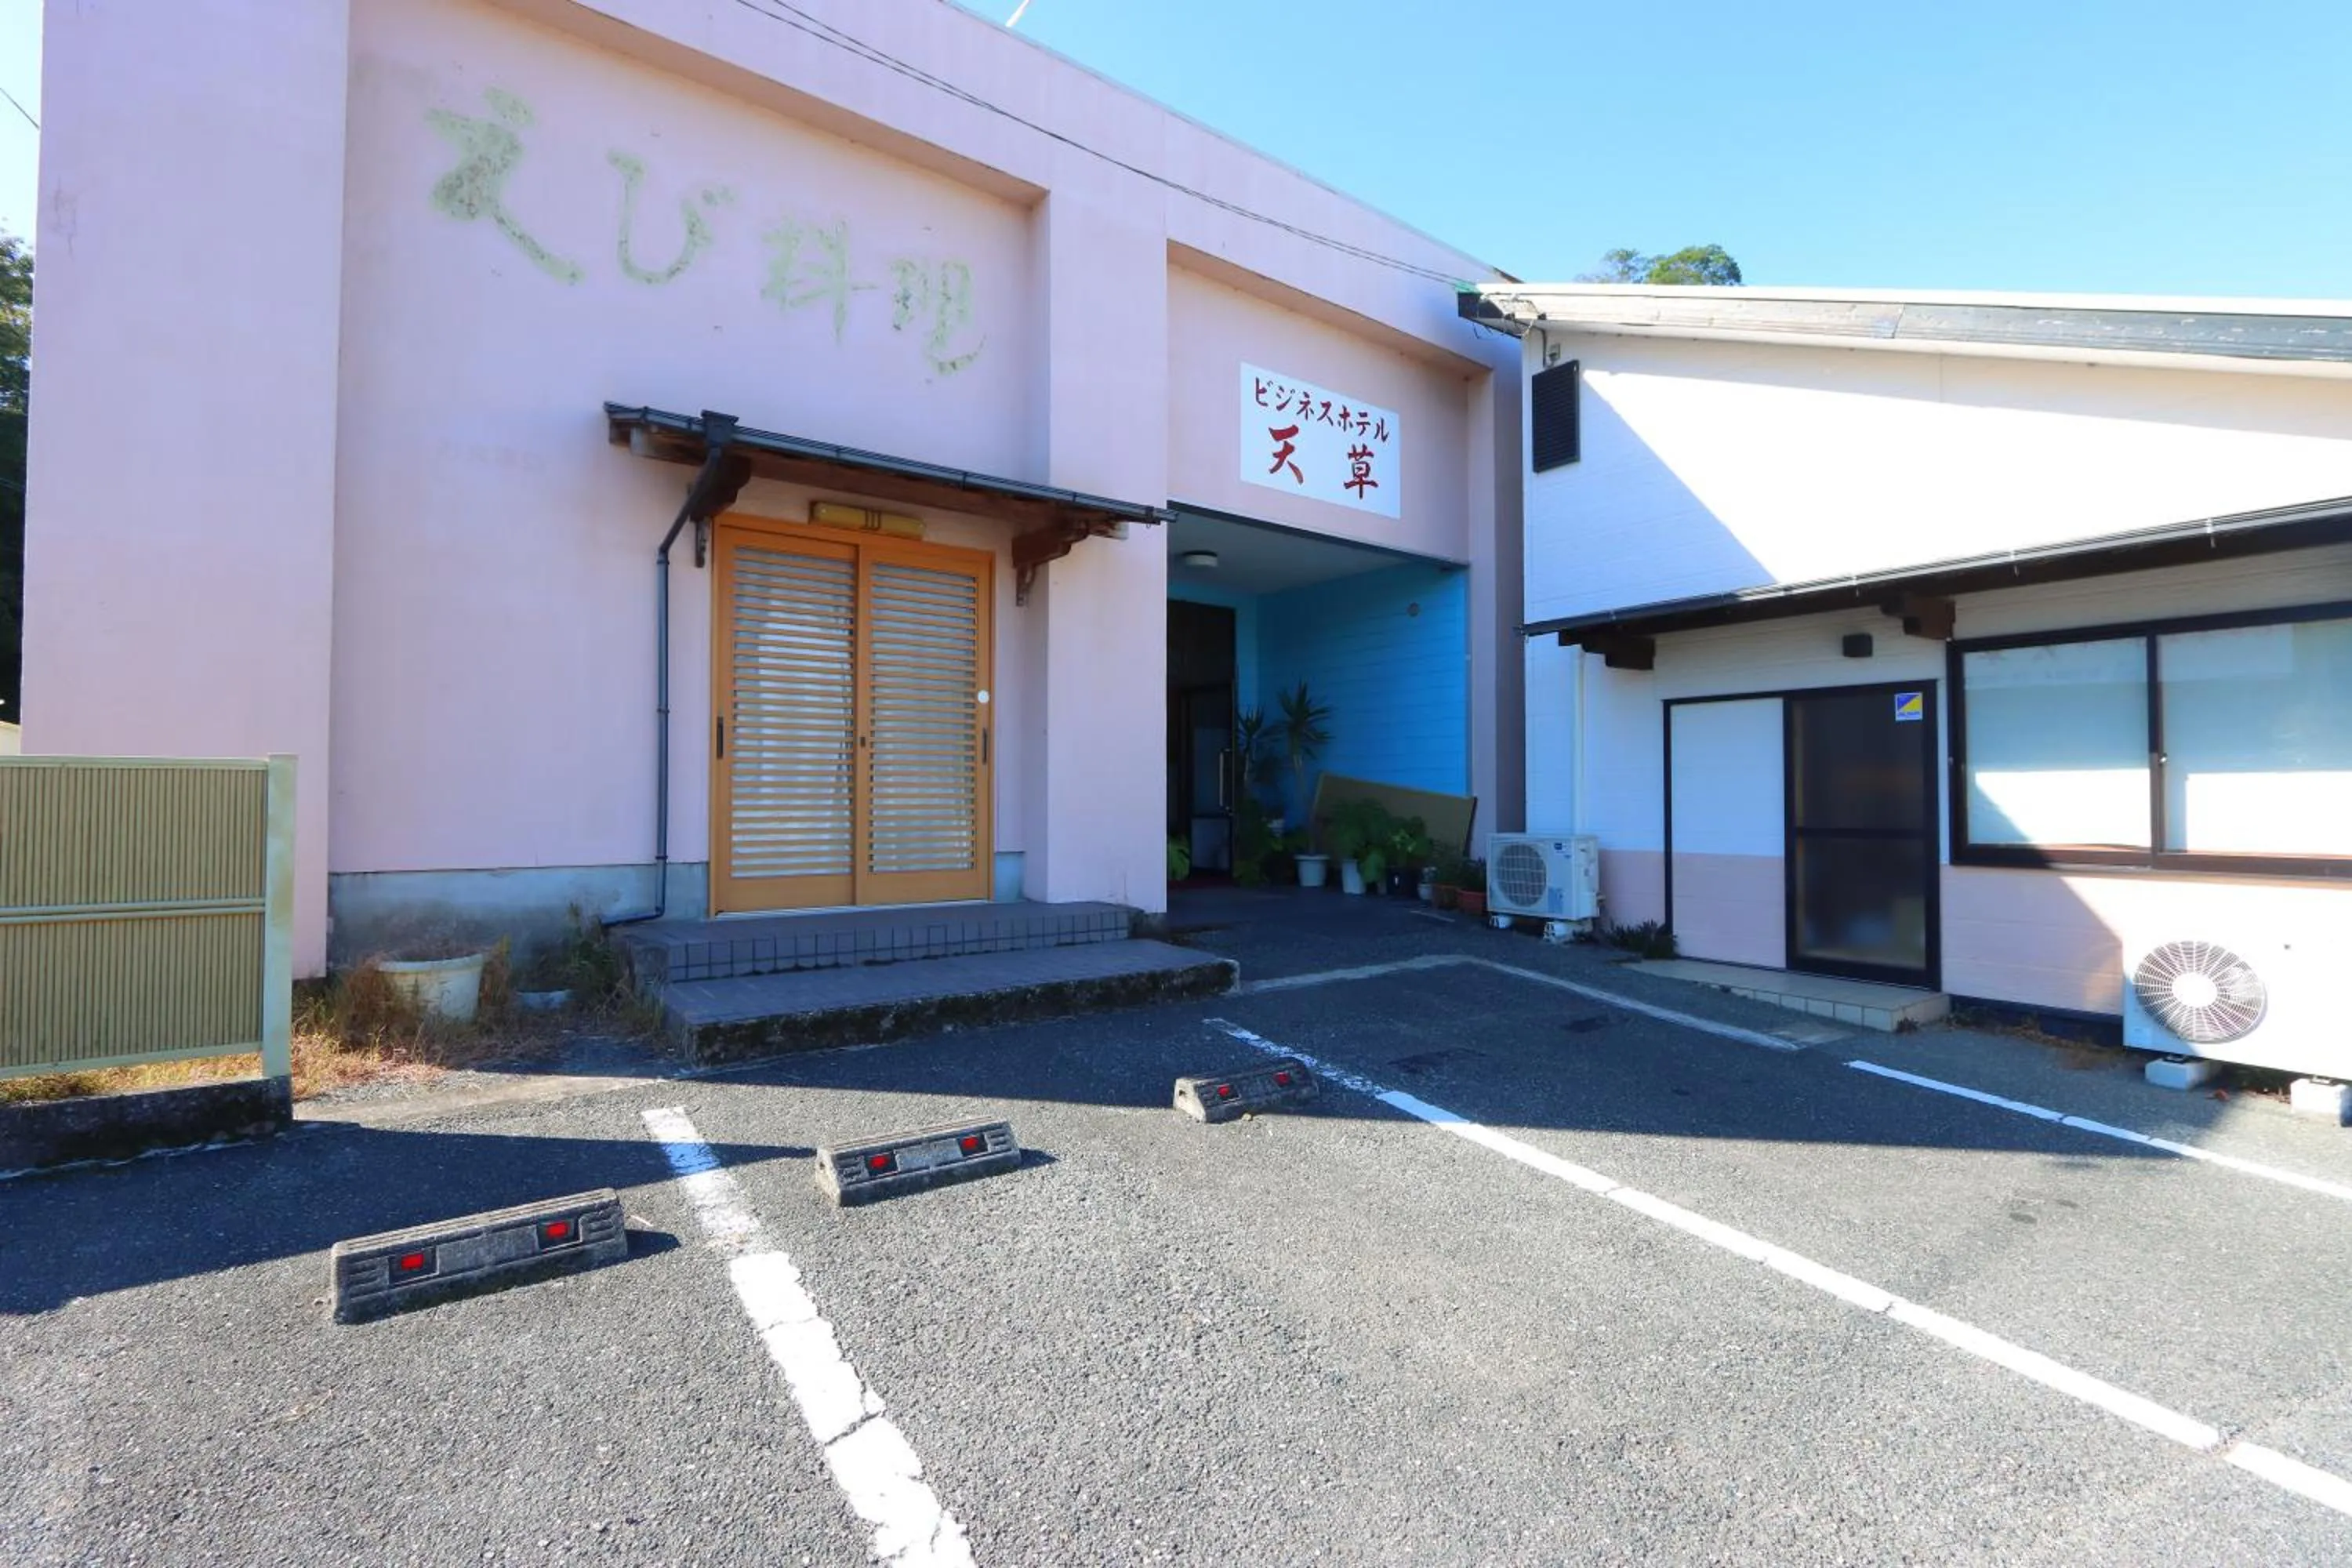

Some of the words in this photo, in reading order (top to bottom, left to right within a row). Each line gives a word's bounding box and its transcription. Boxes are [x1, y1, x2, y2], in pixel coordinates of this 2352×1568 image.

[1255, 376, 1389, 442] ビジネスホテル
[1269, 424, 1379, 499] 天草
